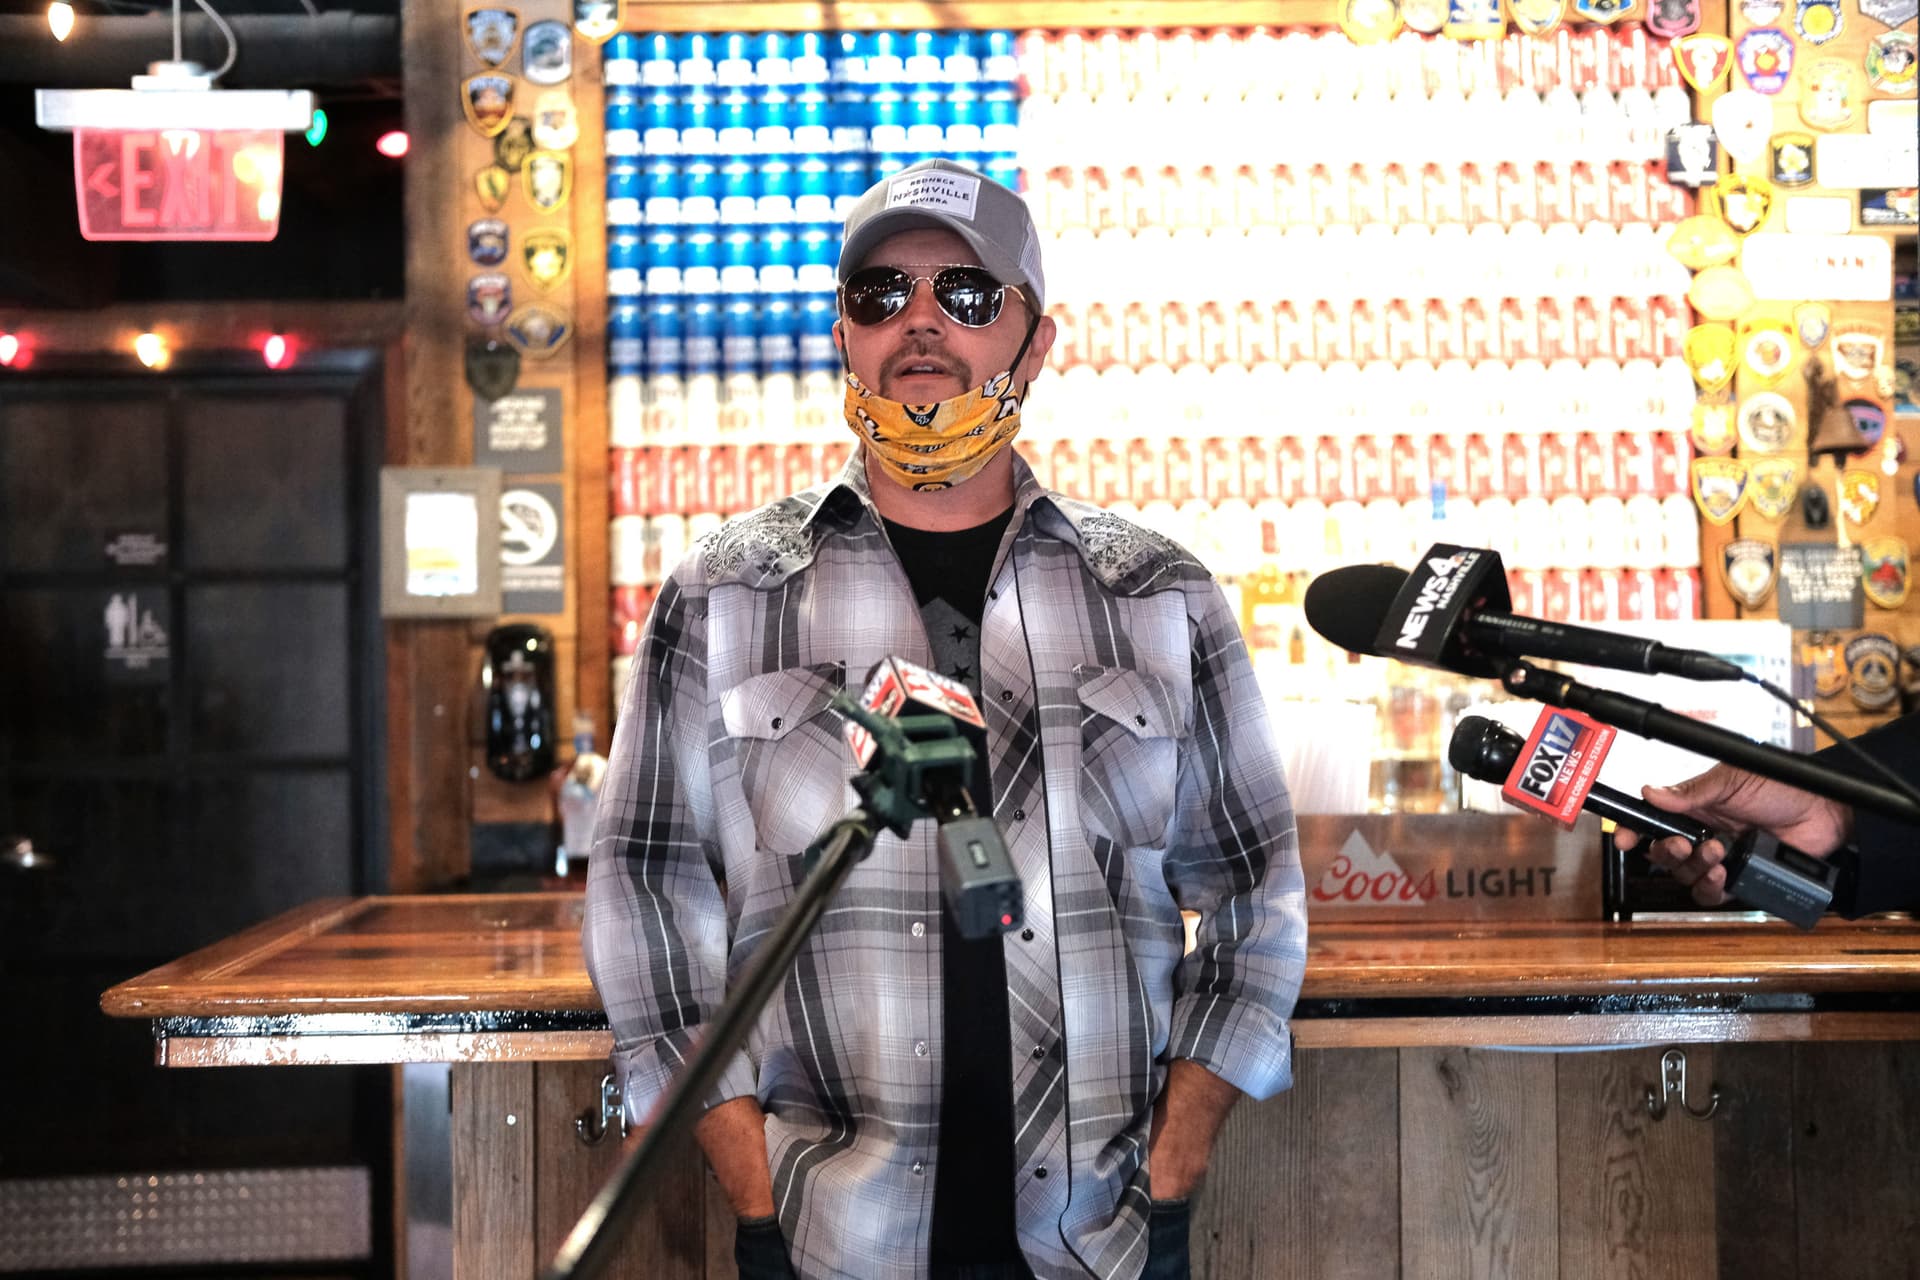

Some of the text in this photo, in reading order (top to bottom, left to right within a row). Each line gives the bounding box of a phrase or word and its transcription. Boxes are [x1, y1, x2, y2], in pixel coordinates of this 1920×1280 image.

[121, 133, 248, 227] EXIT
[910, 177, 954, 186] REDNECK
[910, 196, 948, 205] RIVIERA
[1436, 551, 1480, 609] NASHVILLE
[1522, 715, 1576, 797] FOX 17
[1559, 749, 1583, 785] NEWS
[1561, 729, 1609, 817] YOUR CODE RED STATION
[1312, 855, 1556, 901] Coors LIGHT
